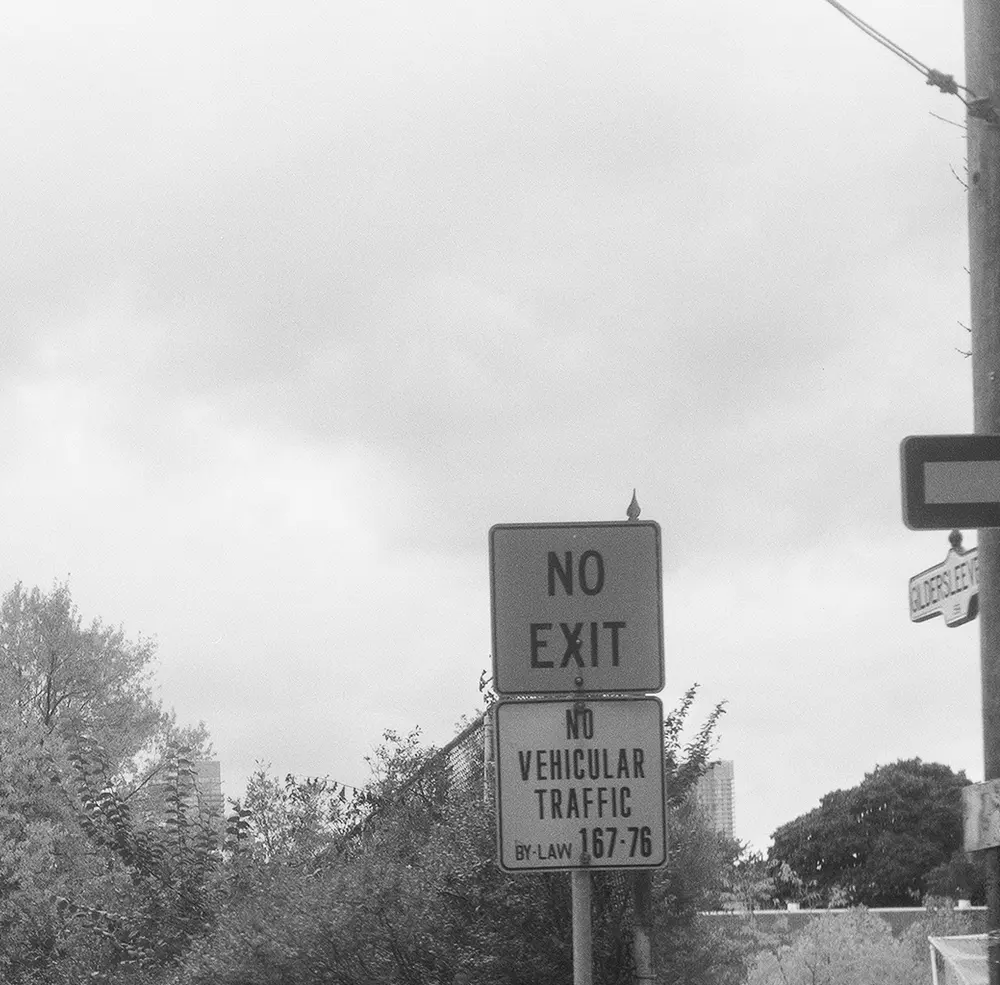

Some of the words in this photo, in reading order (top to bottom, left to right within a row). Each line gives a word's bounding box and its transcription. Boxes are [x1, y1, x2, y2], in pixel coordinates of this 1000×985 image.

[548, 550, 605, 597] NO
[530, 620, 626, 669] EXIT
[565, 708, 594, 740] NO
[518, 748, 645, 781] VEHICULAR
[534, 786, 632, 820] TRAFFIC
[515, 842, 572, 861] BY-LAW
